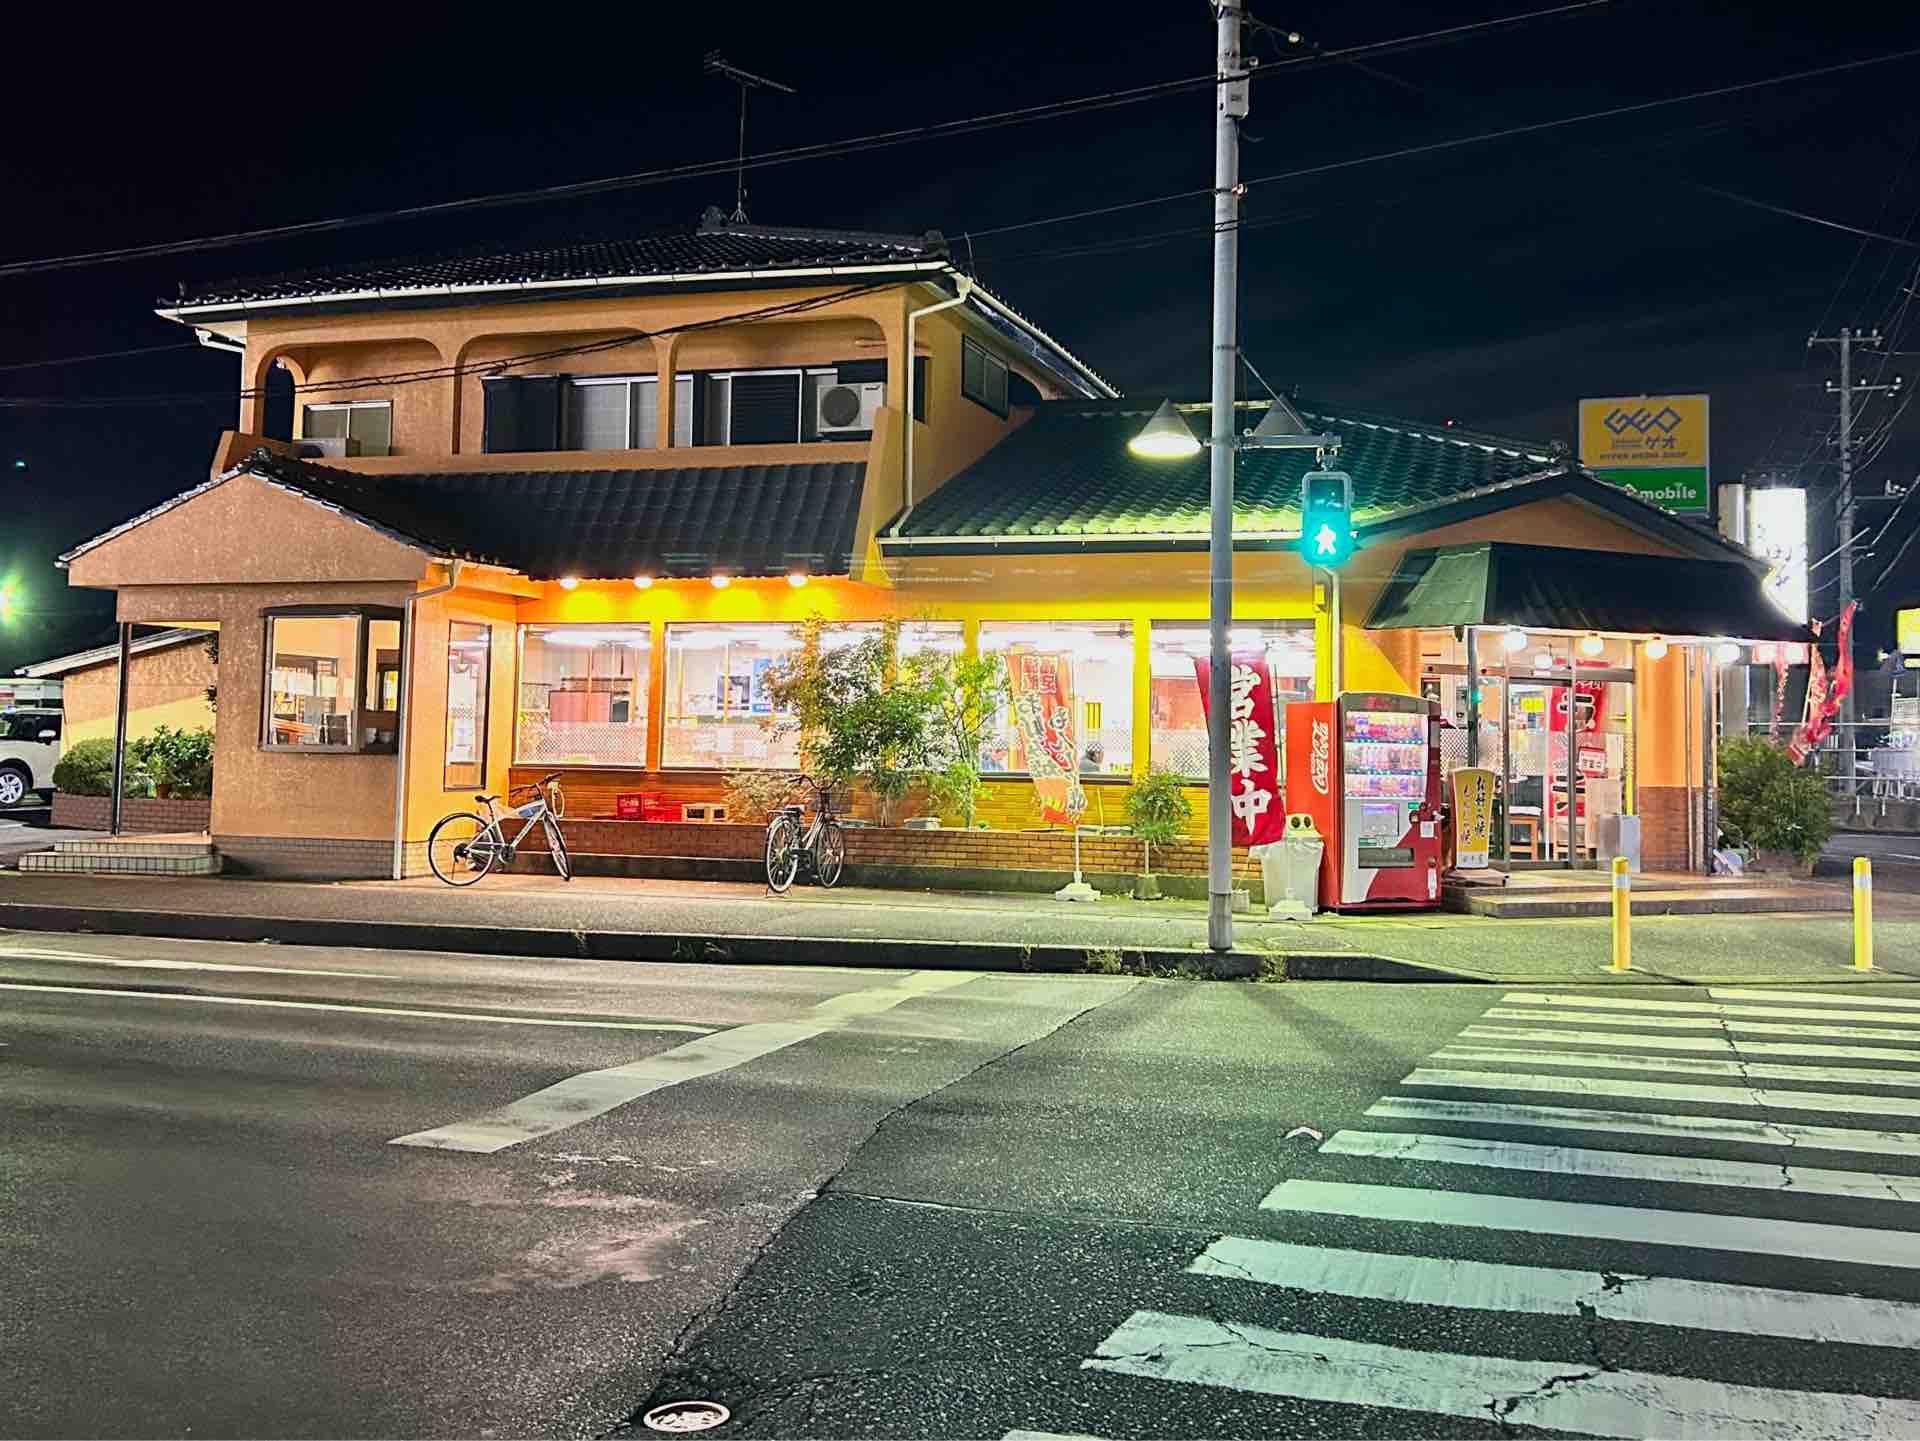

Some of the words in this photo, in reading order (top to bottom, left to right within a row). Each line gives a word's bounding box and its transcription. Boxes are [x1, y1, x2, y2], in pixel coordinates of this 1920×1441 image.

[1605, 407, 1681, 432] GEO
[1646, 434, 1677, 448] ゲオ
[1231, 664, 1272, 836] 営業中
[1311, 717, 1329, 795] Coca-Cola
